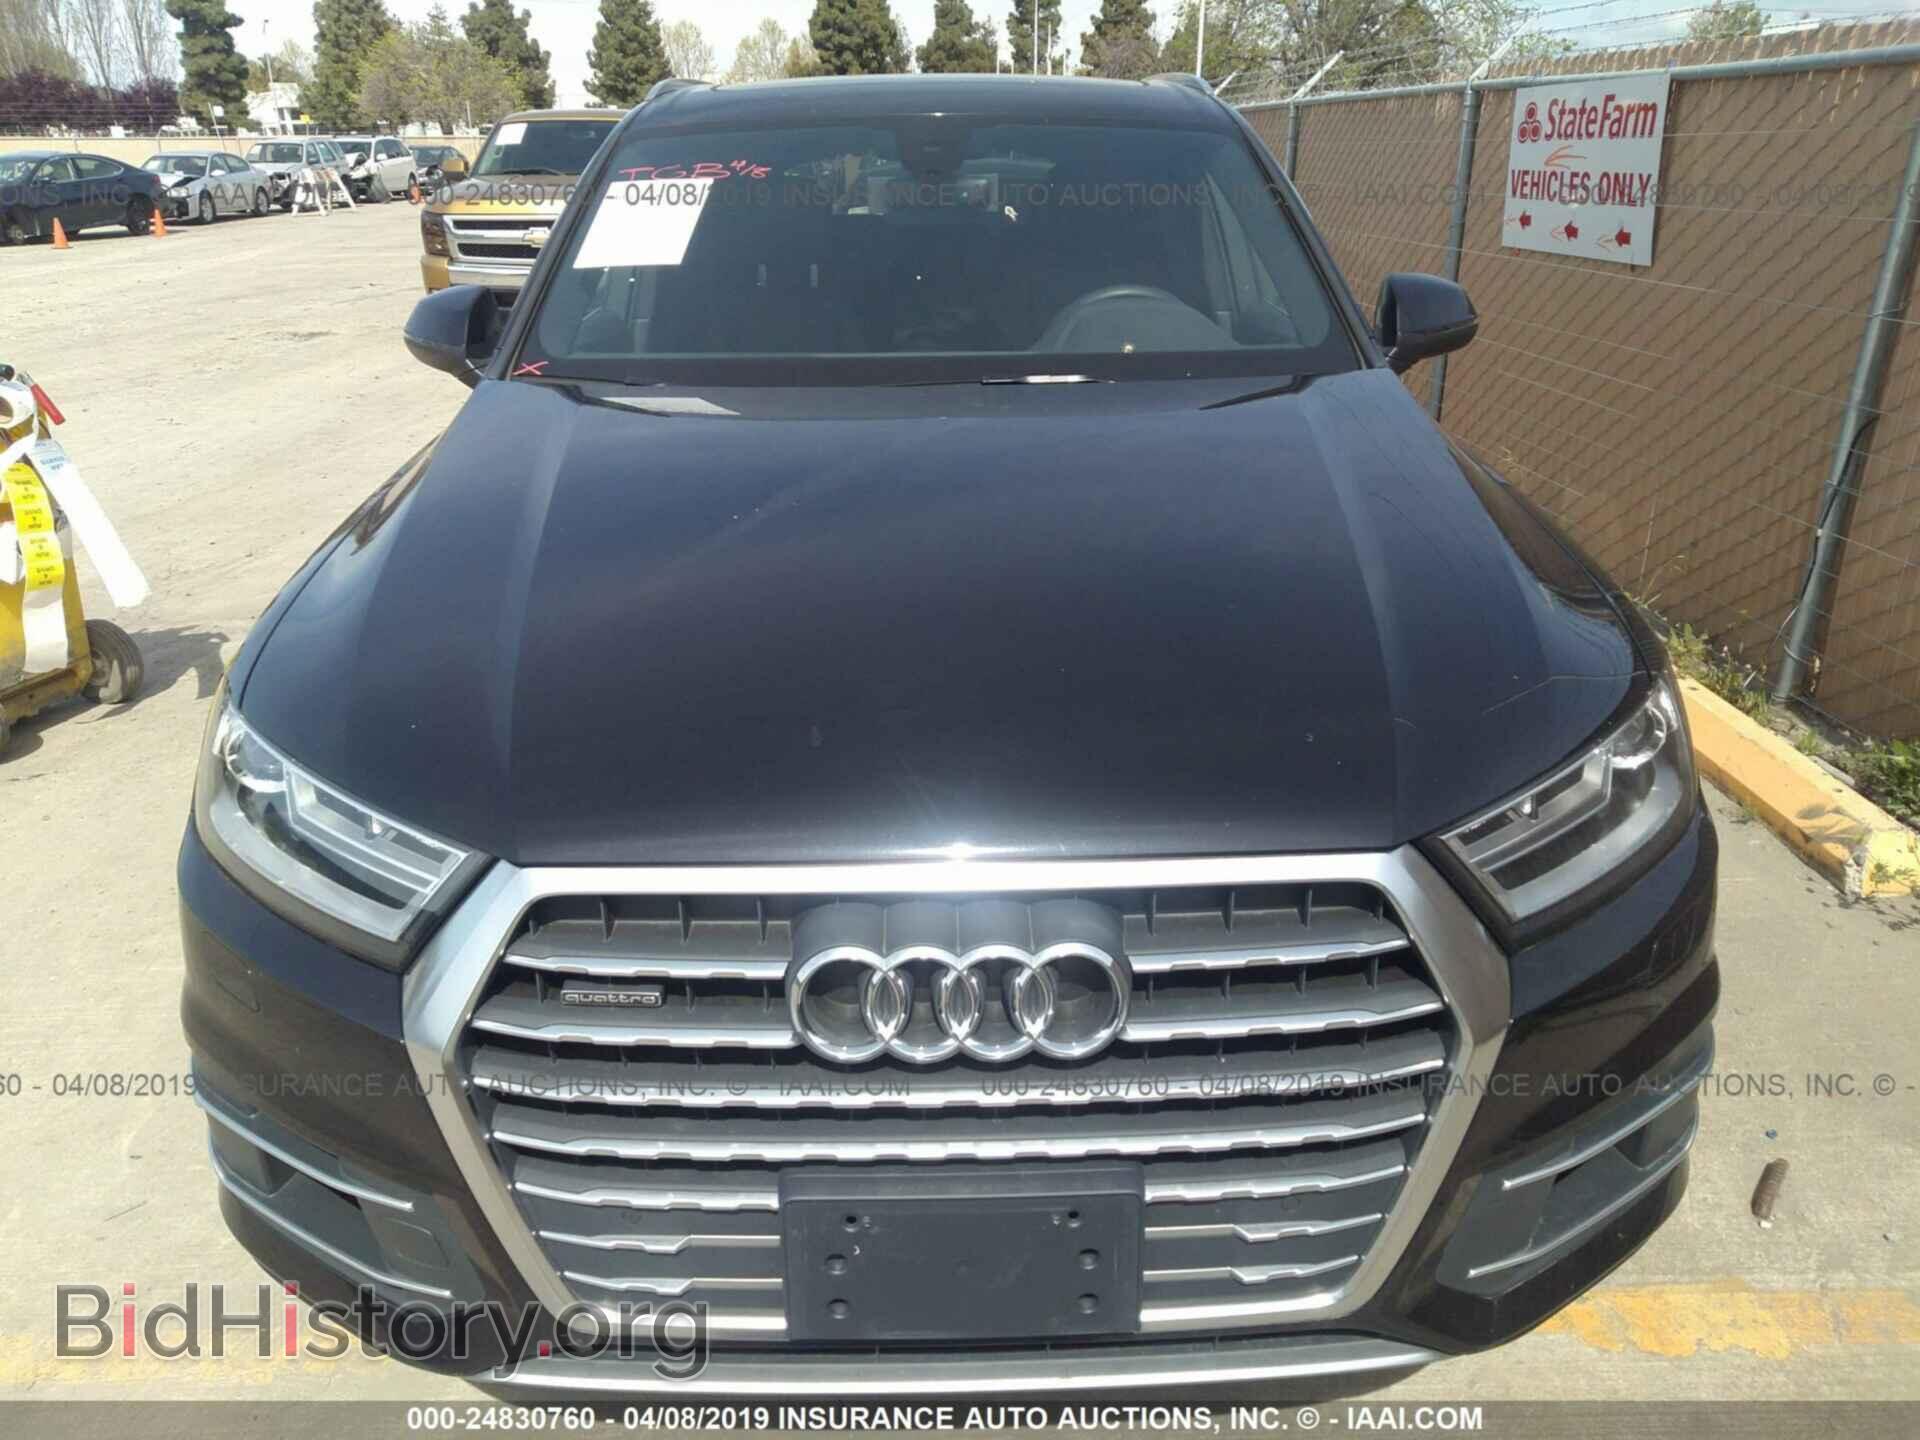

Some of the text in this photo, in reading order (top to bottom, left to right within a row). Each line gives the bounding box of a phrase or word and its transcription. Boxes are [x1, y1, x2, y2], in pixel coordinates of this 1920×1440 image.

[1511, 169, 1652, 208] VEHICLES ONLY
[564, 993, 656, 1004] quattro
